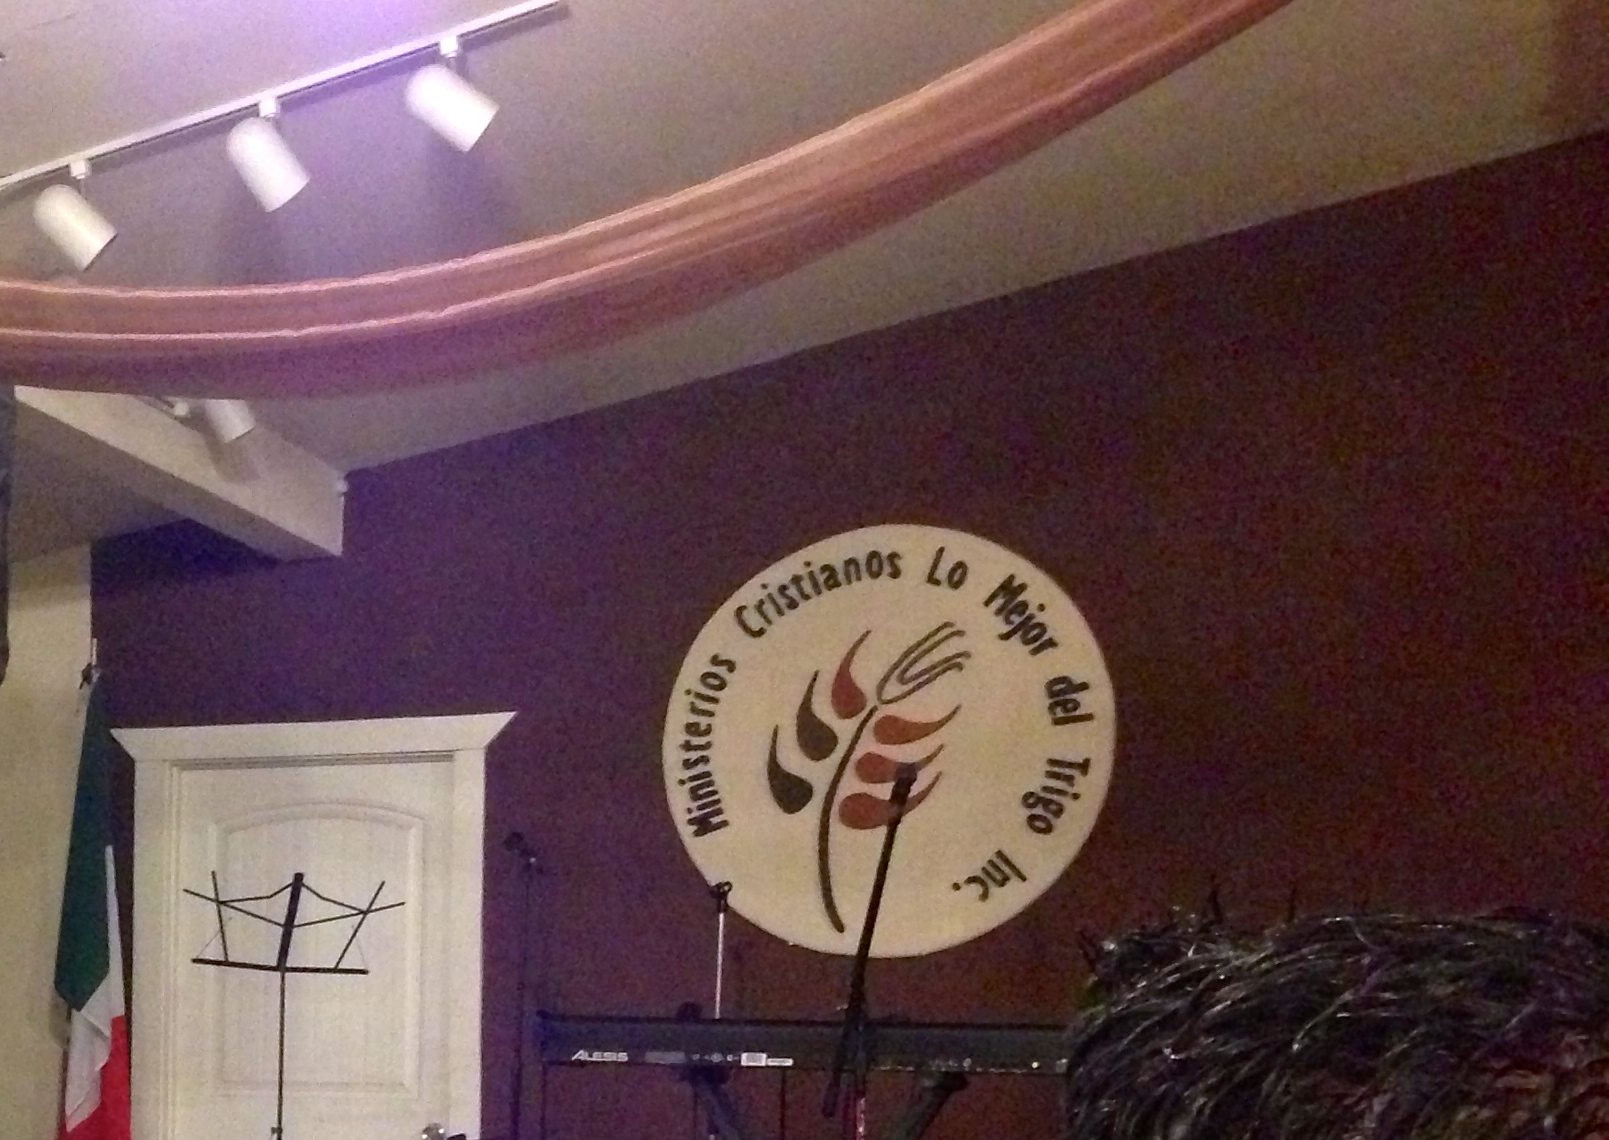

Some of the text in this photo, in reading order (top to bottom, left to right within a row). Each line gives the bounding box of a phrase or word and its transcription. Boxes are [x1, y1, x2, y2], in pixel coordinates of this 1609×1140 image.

[678, 546, 1095, 902] Ministerios Cristianos Lo Mejor del Trigo Inc.
